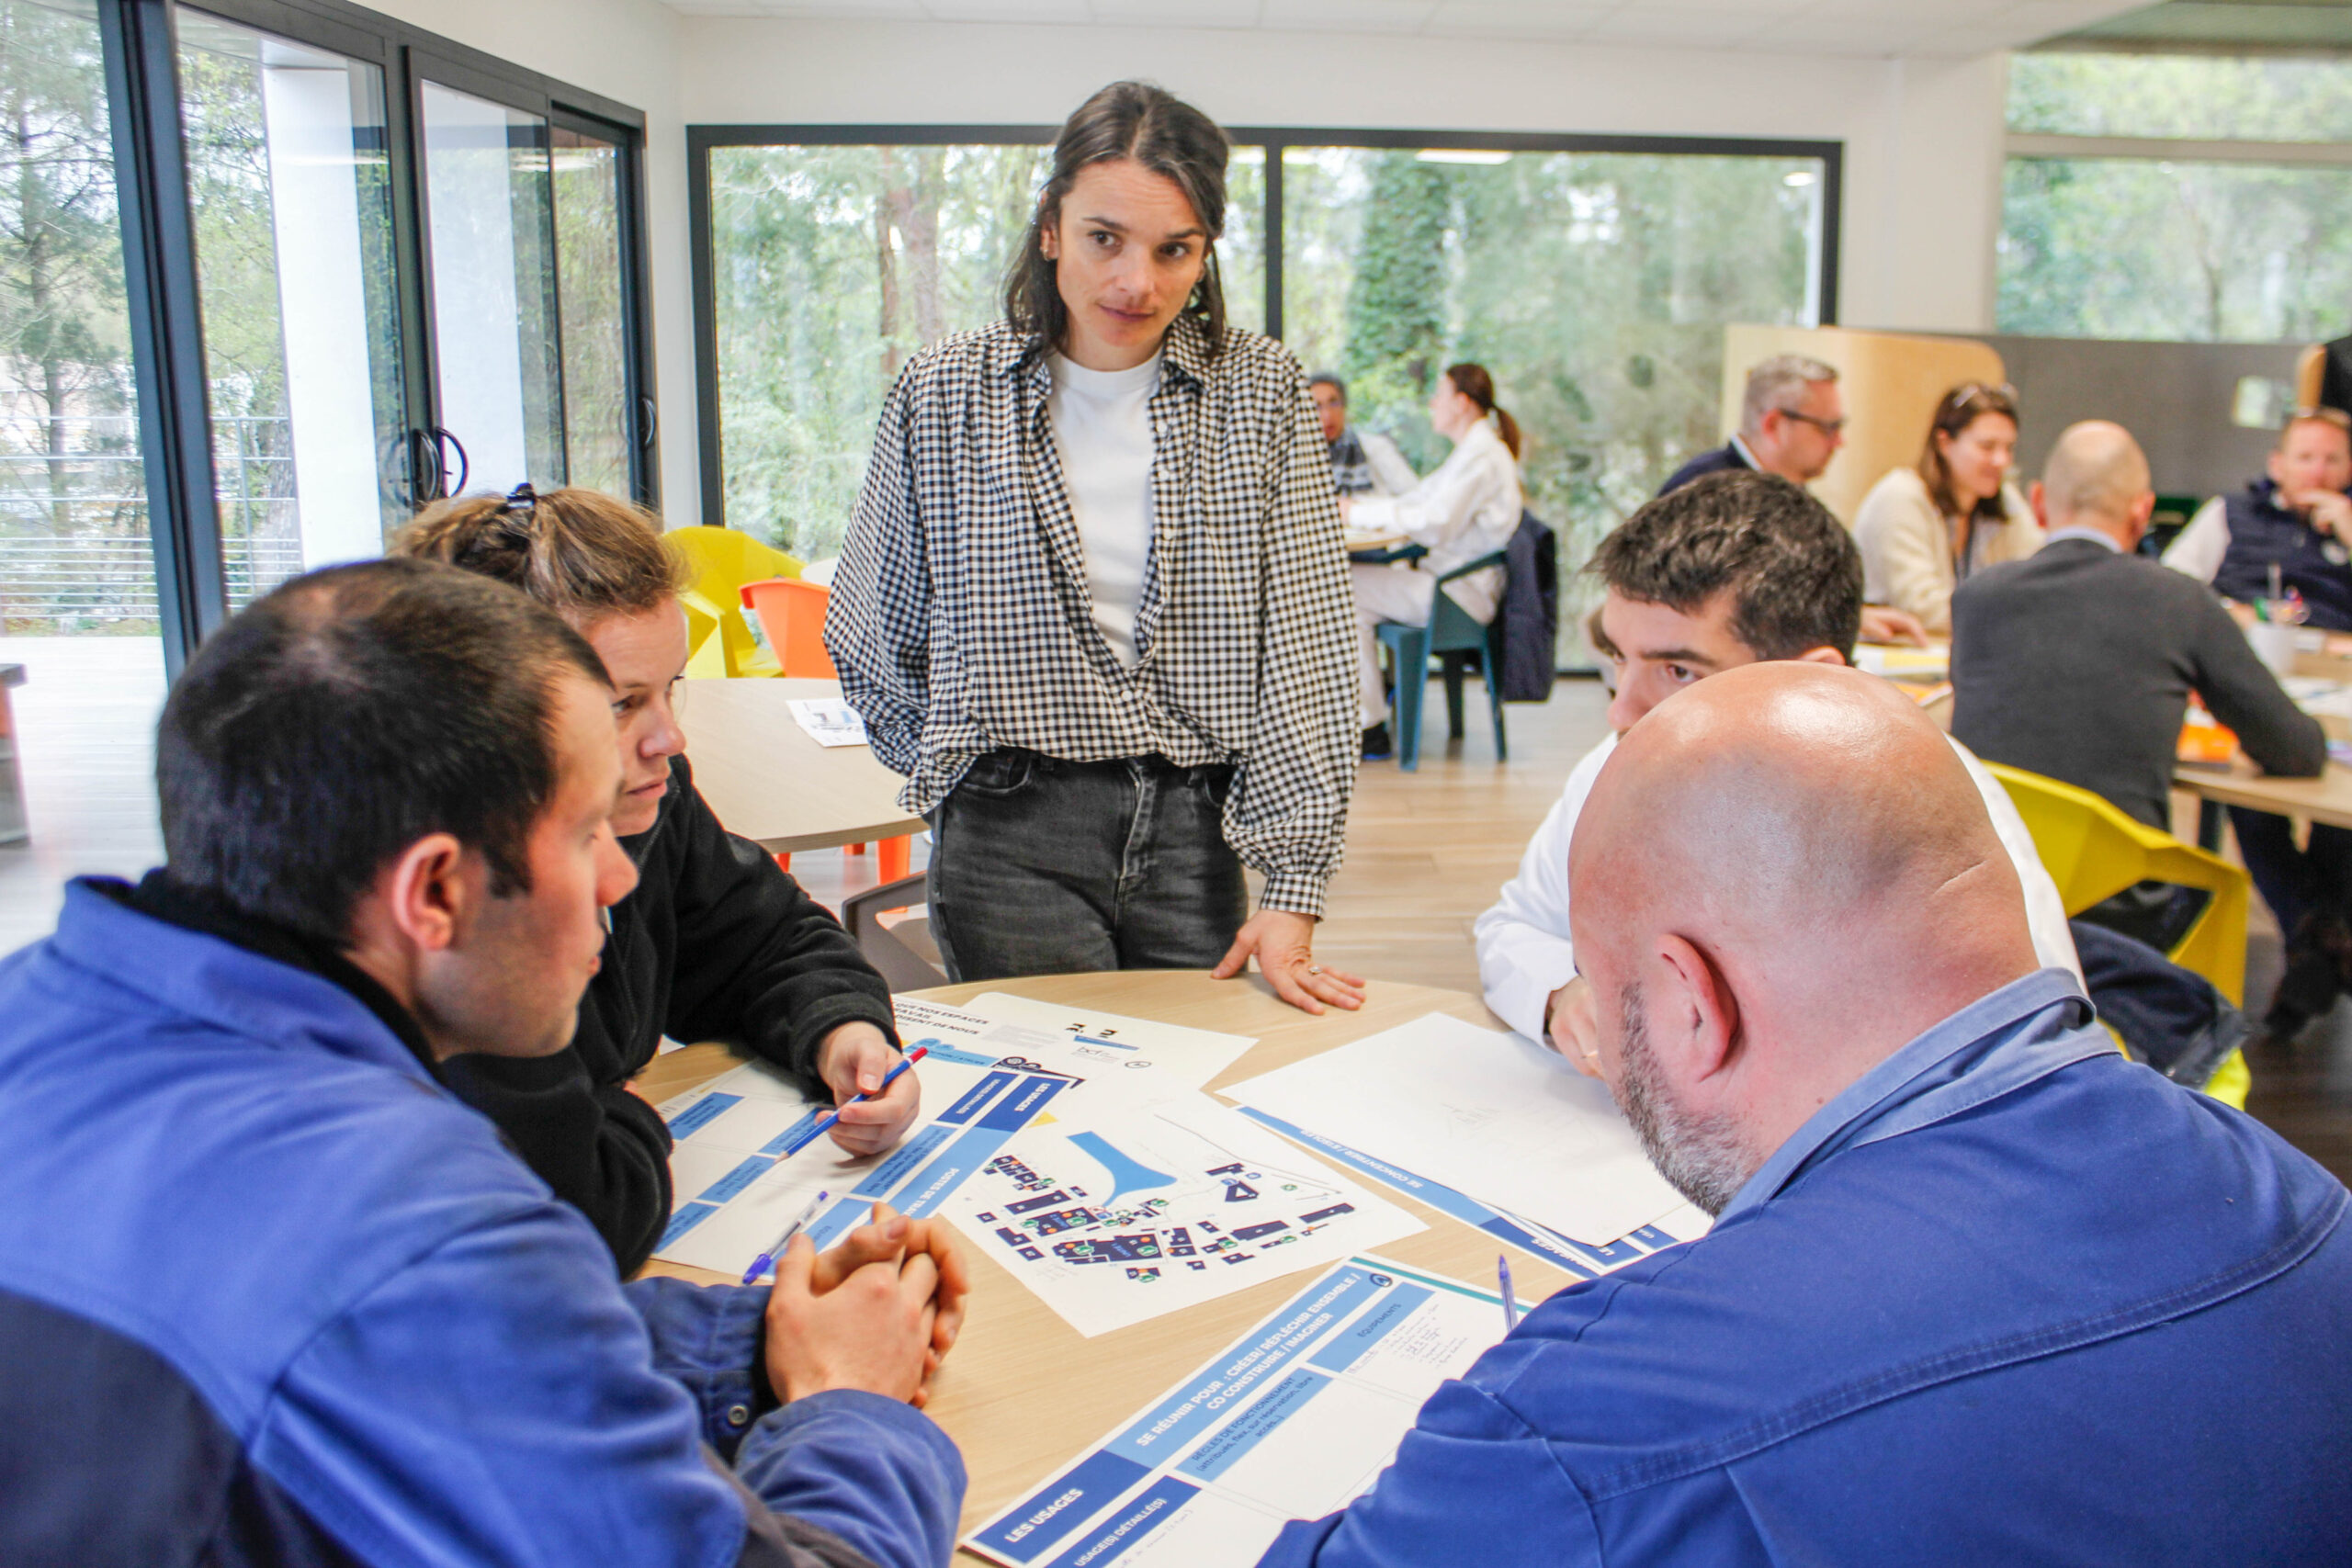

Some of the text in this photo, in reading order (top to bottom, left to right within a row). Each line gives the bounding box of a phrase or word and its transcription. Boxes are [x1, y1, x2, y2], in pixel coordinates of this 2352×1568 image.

[942, 1011, 989, 1024] ESPACES
[1136, 1432, 1157, 1447] SE
[1151, 1403, 1196, 1435] RÉUNIR
[1190, 1381, 1225, 1404] POUR
[1259, 1312, 1312, 1350] RÉFLÉCHIR
[1306, 1277, 1357, 1314] ENSEMBLE
[1206, 1396, 1227, 1410] CO
[1222, 1349, 1286, 1397] CONSTRUIRE
[1284, 1312, 1333, 1348] IMAGINER
[1219, 1427, 1235, 1439] DE
[1004, 1487, 1084, 1543] LES USAGES
[1073, 1535, 1121, 1566] USAGE(S)
[1113, 1497, 1168, 1537] DÉTAILLÉ(S)
